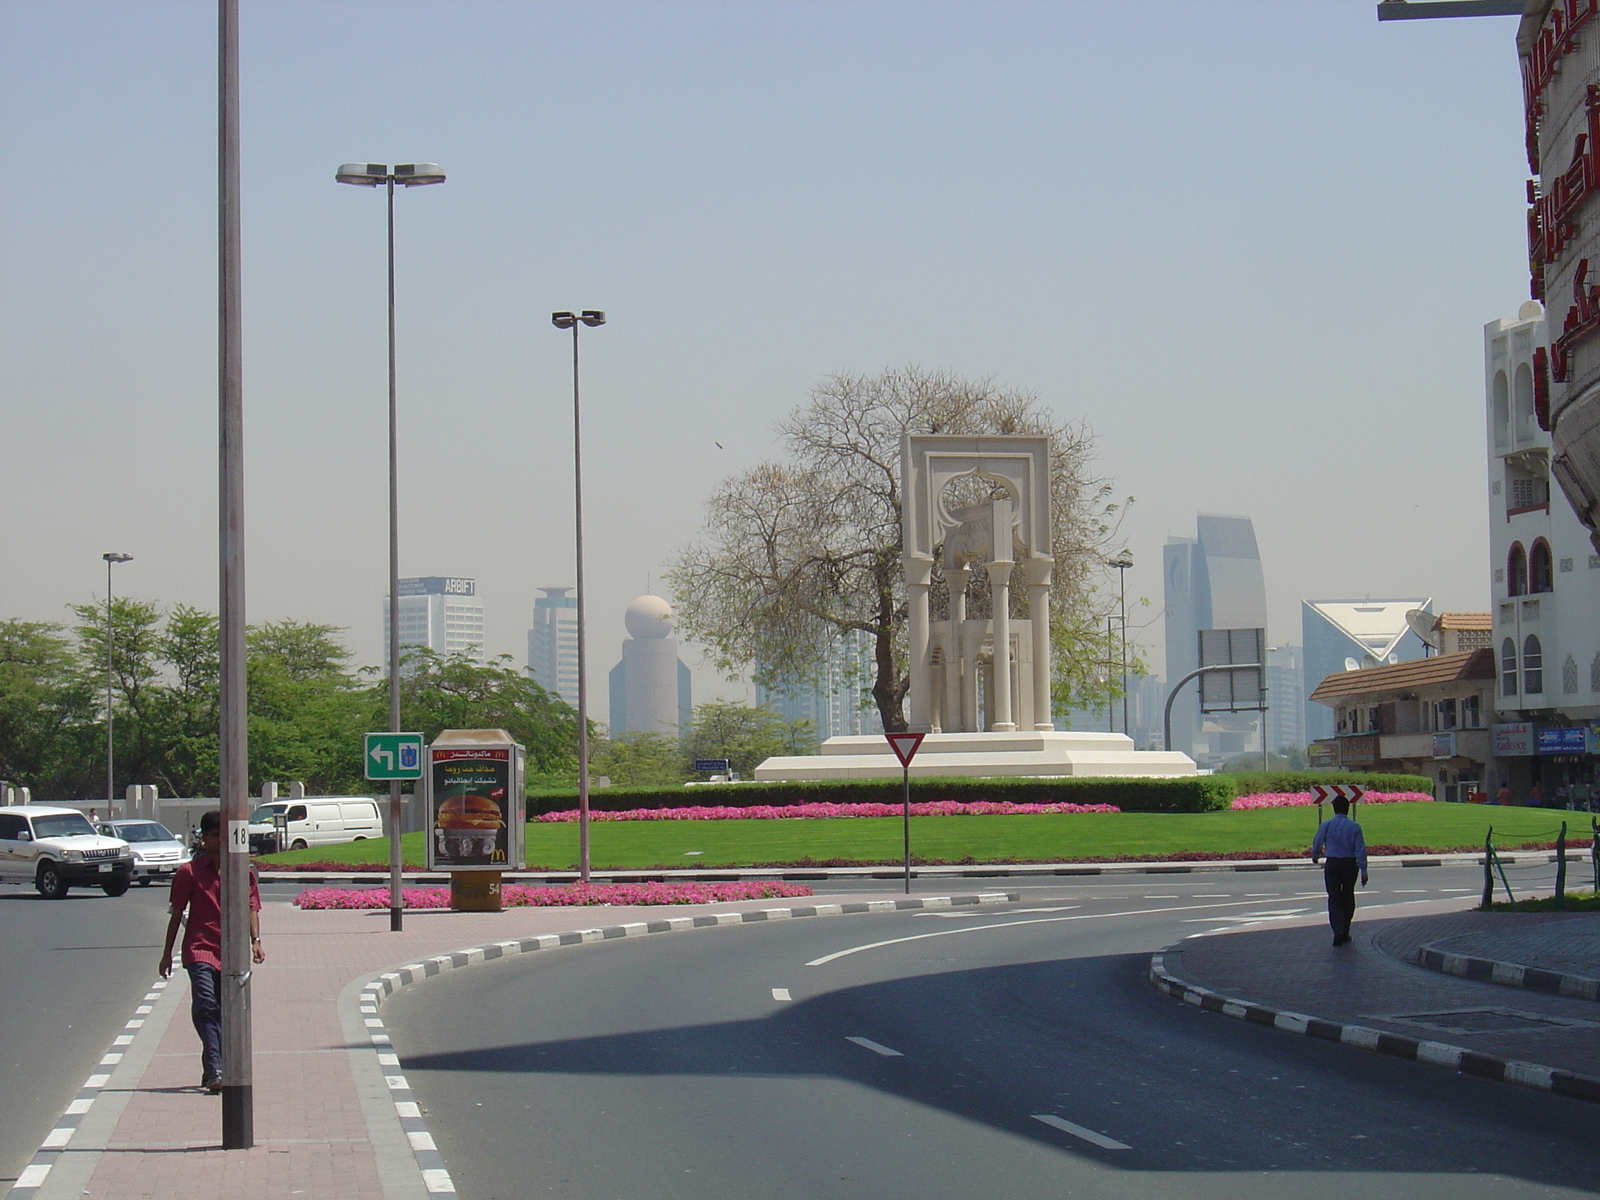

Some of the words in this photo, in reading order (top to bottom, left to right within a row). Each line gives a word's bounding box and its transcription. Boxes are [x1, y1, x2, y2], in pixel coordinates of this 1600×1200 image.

[445, 578, 475, 594] ARBIFT
[450, 750, 491, 759] ماكدونالدز
[233, 828, 246, 844] 18
[488, 882, 500, 895] 54
